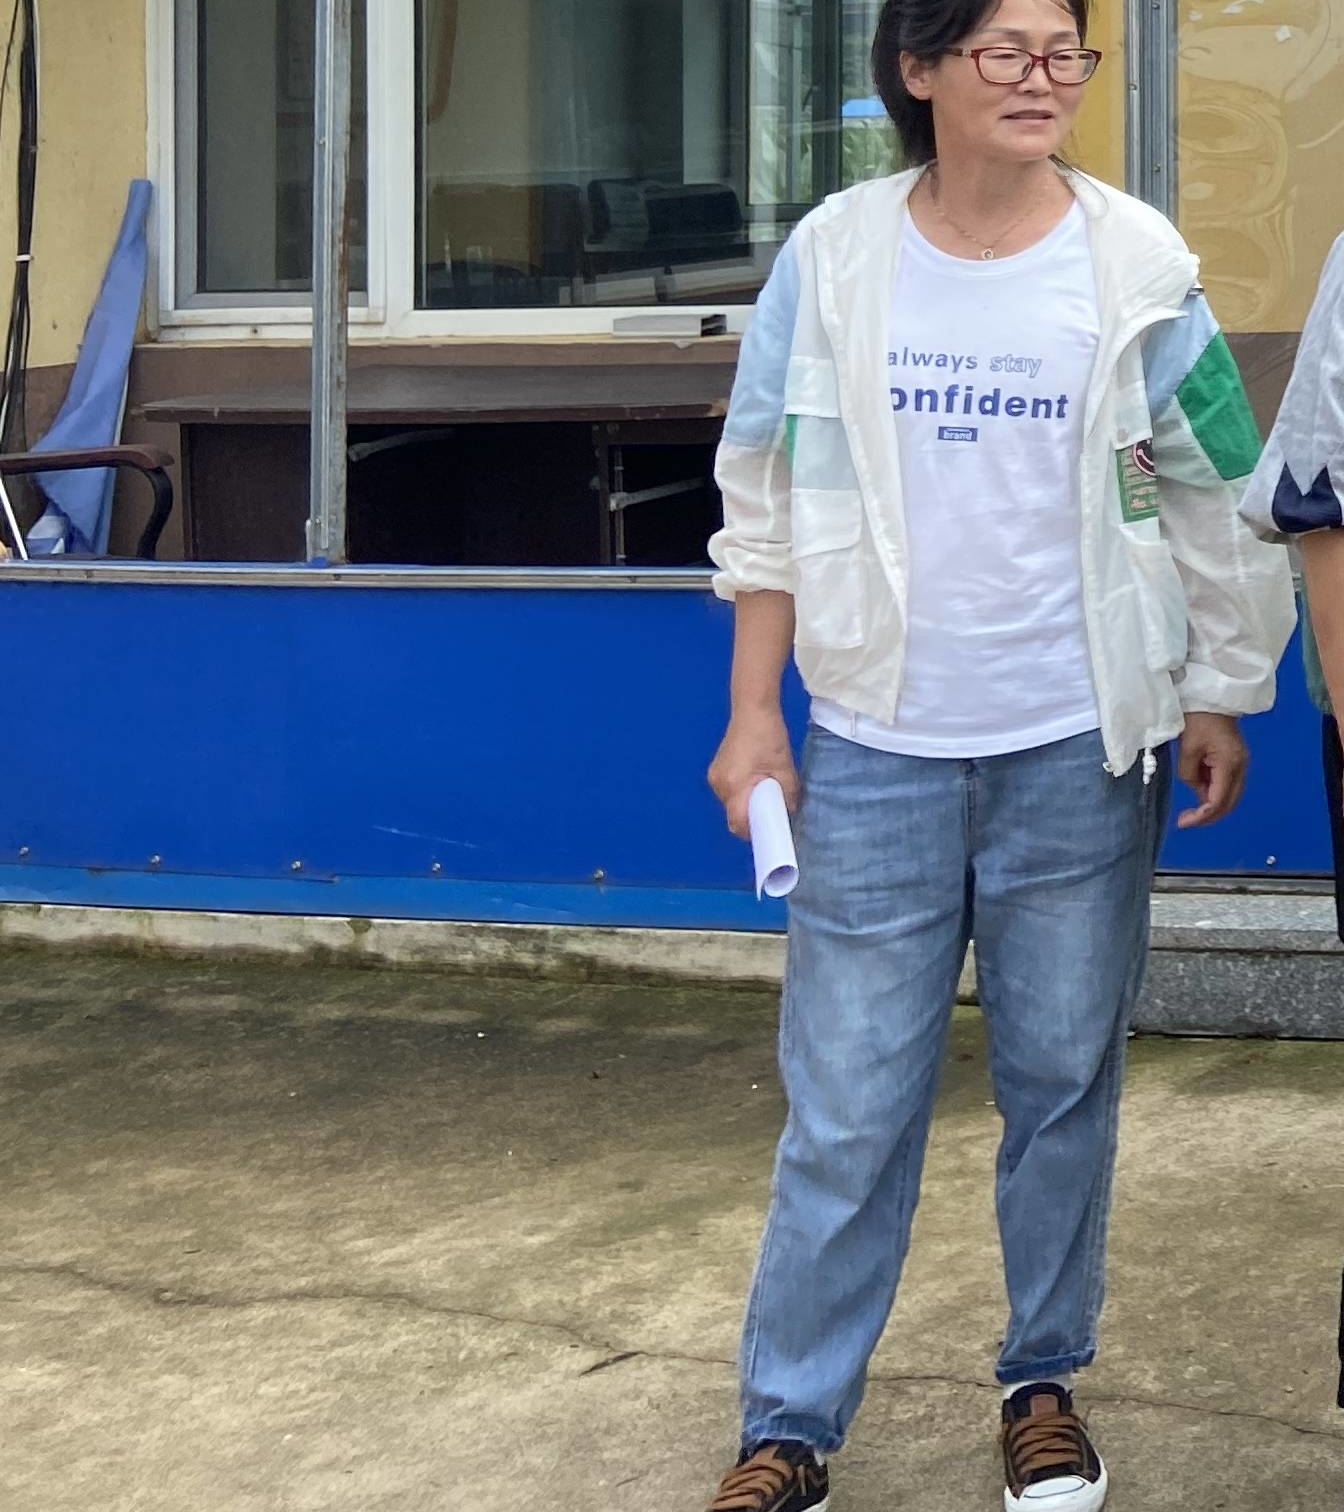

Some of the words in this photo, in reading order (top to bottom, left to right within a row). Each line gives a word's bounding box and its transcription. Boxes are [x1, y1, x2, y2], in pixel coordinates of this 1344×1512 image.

[888, 346, 978, 373] always
[989, 354, 1042, 378] stay
[889, 384, 1068, 419] onfident
